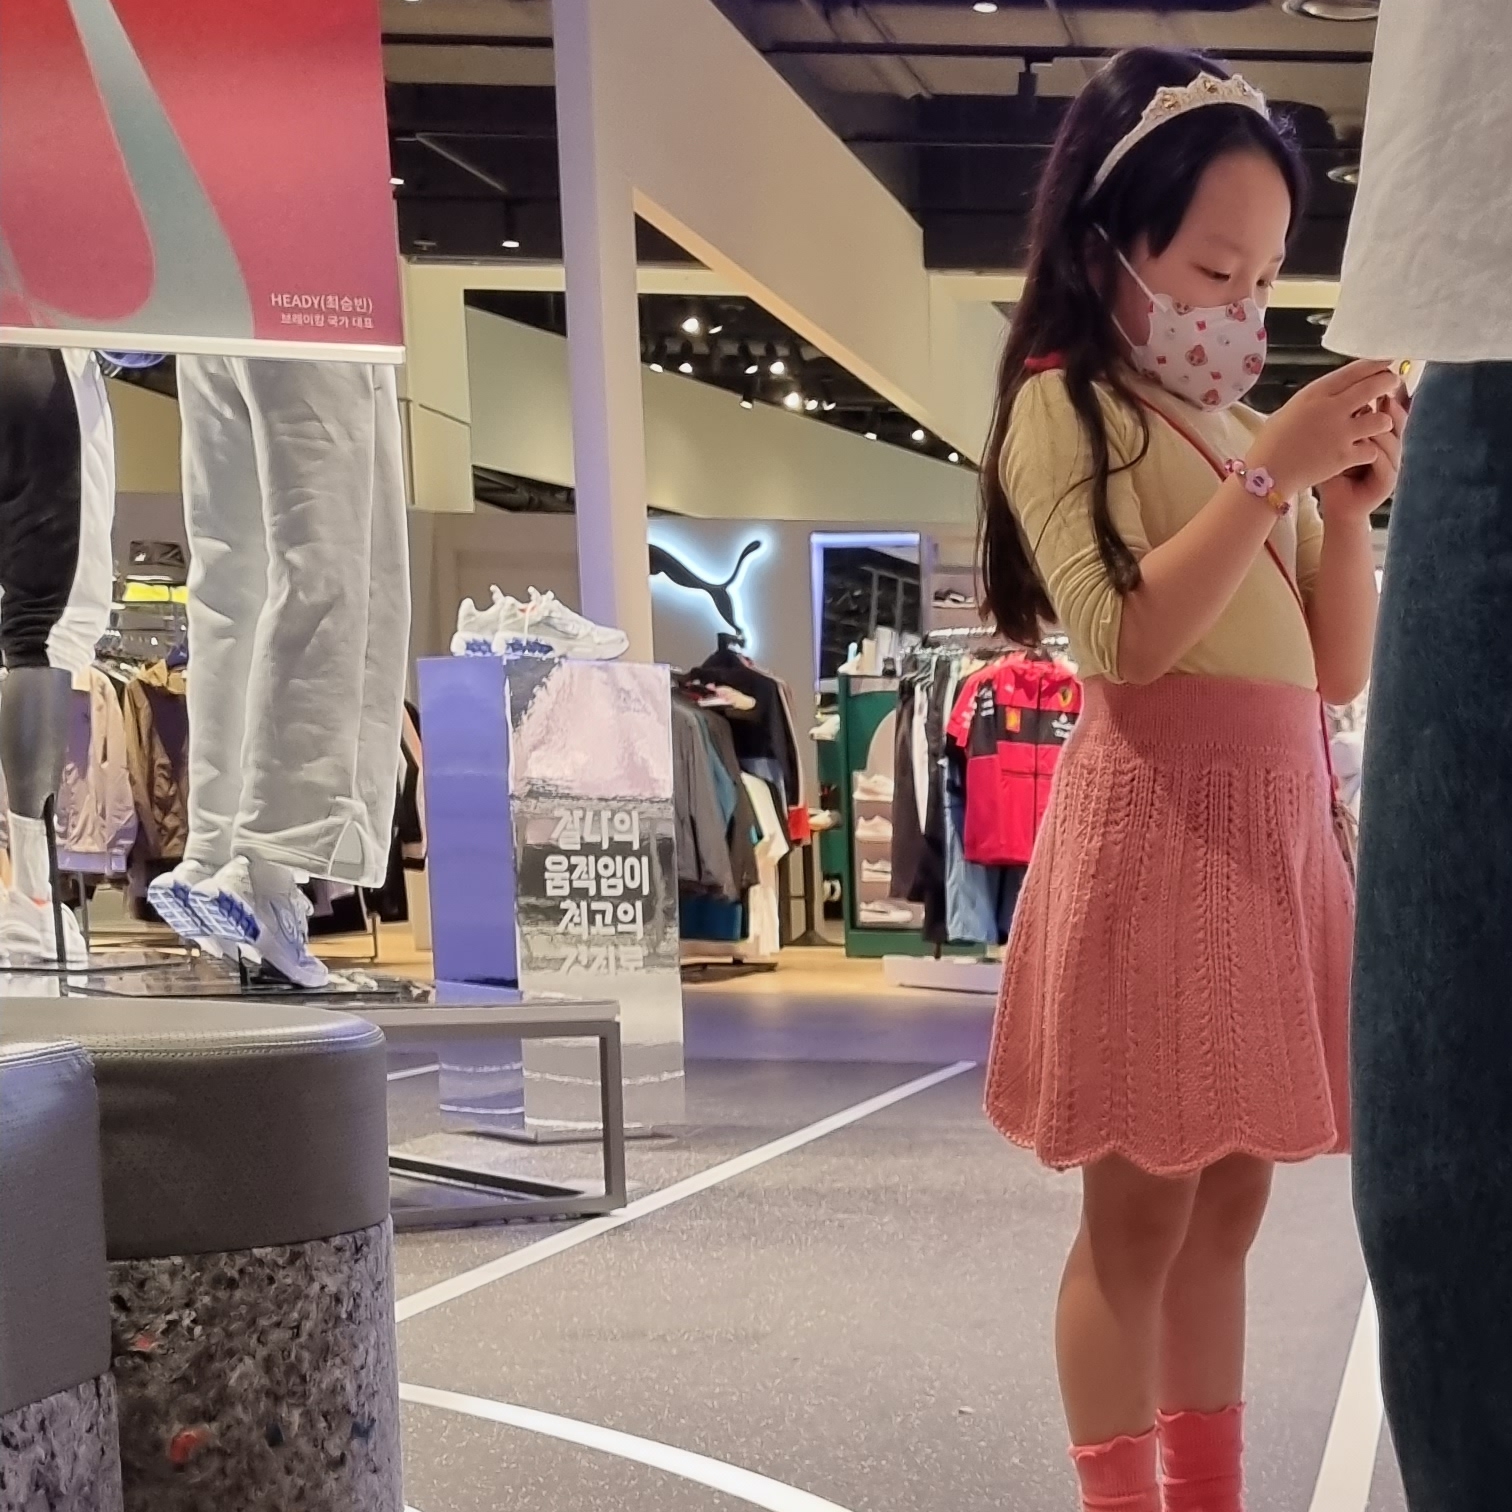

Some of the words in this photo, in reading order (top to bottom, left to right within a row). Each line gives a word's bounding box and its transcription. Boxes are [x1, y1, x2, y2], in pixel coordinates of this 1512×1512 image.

[327, 315, 349, 328] 국가
[352, 317, 374, 329] 대표
[544, 855, 649, 897] 움직임이
[557, 900, 644, 940] 최고의
